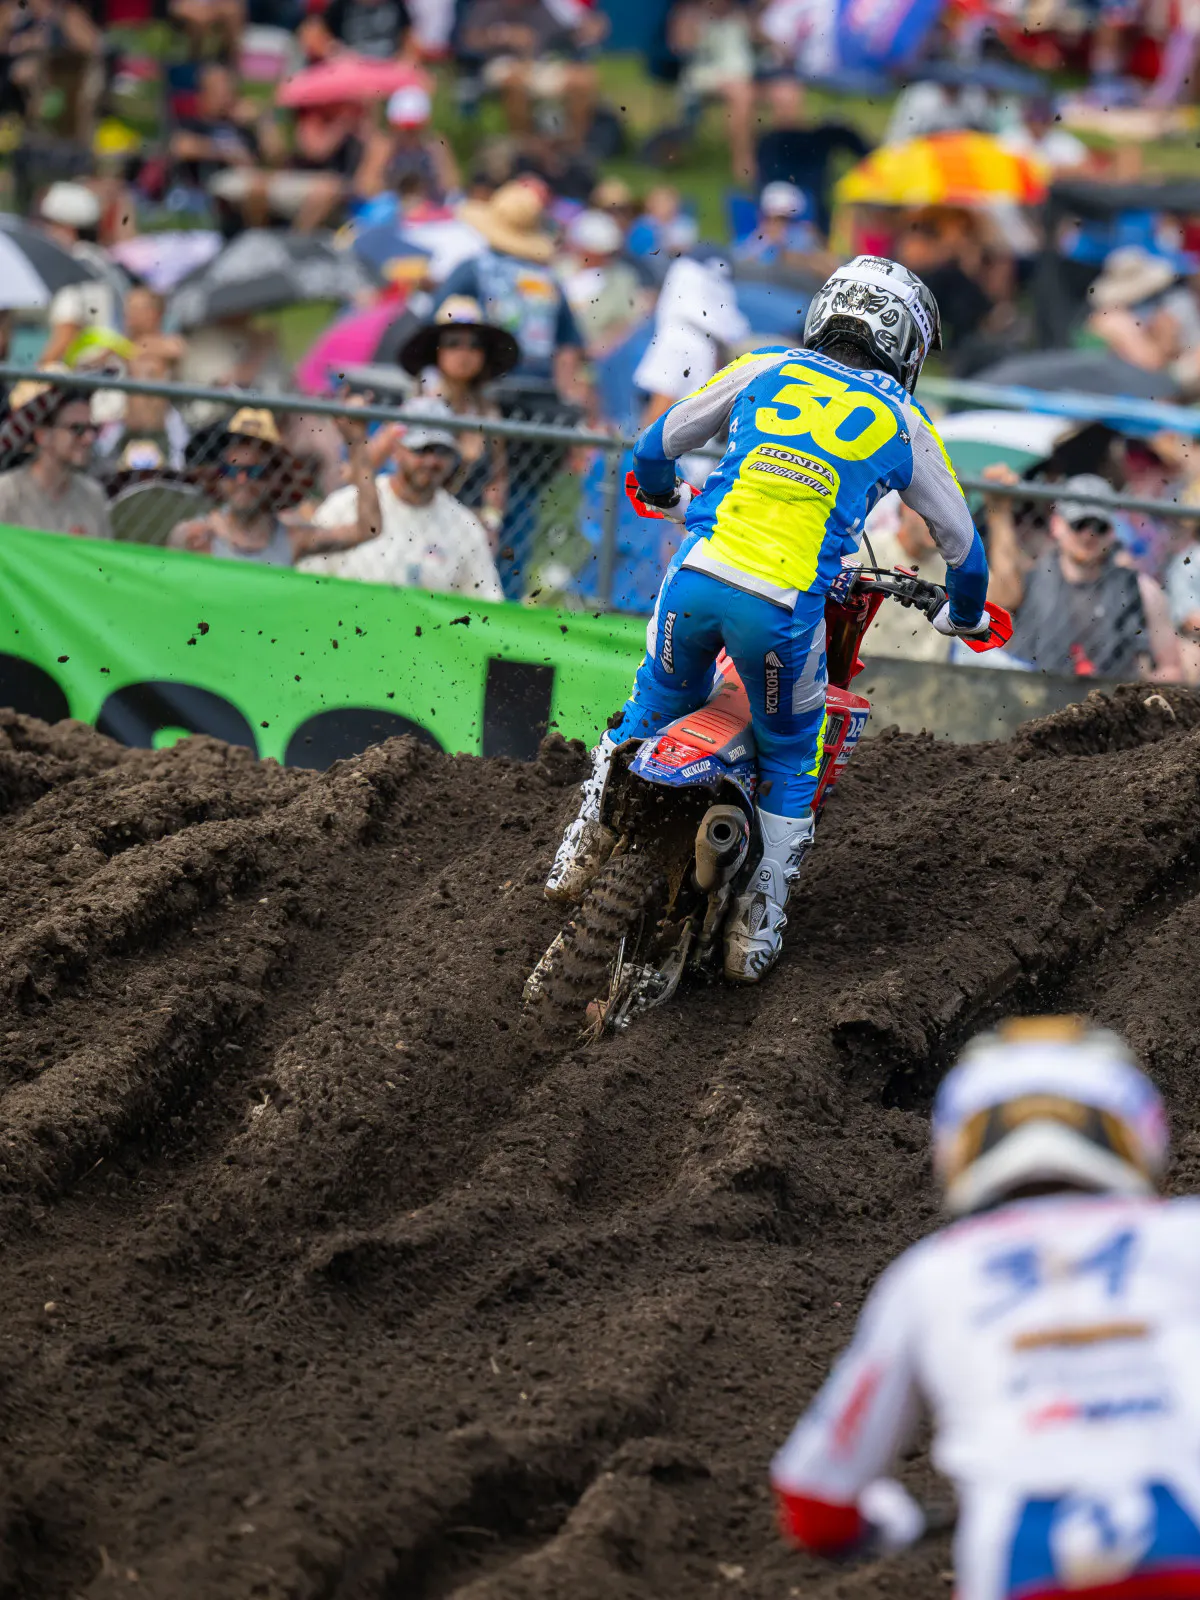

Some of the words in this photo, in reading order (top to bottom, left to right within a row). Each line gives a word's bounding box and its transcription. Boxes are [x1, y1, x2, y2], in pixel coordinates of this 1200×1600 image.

[755, 363, 898, 462] 30
[748, 461, 833, 497] PROGRESSIVE
[757, 446, 835, 487] HONDA
[662, 610, 678, 665] HONDA
[765, 668, 780, 715] HONDA
[681, 760, 711, 778] DUNLOP
